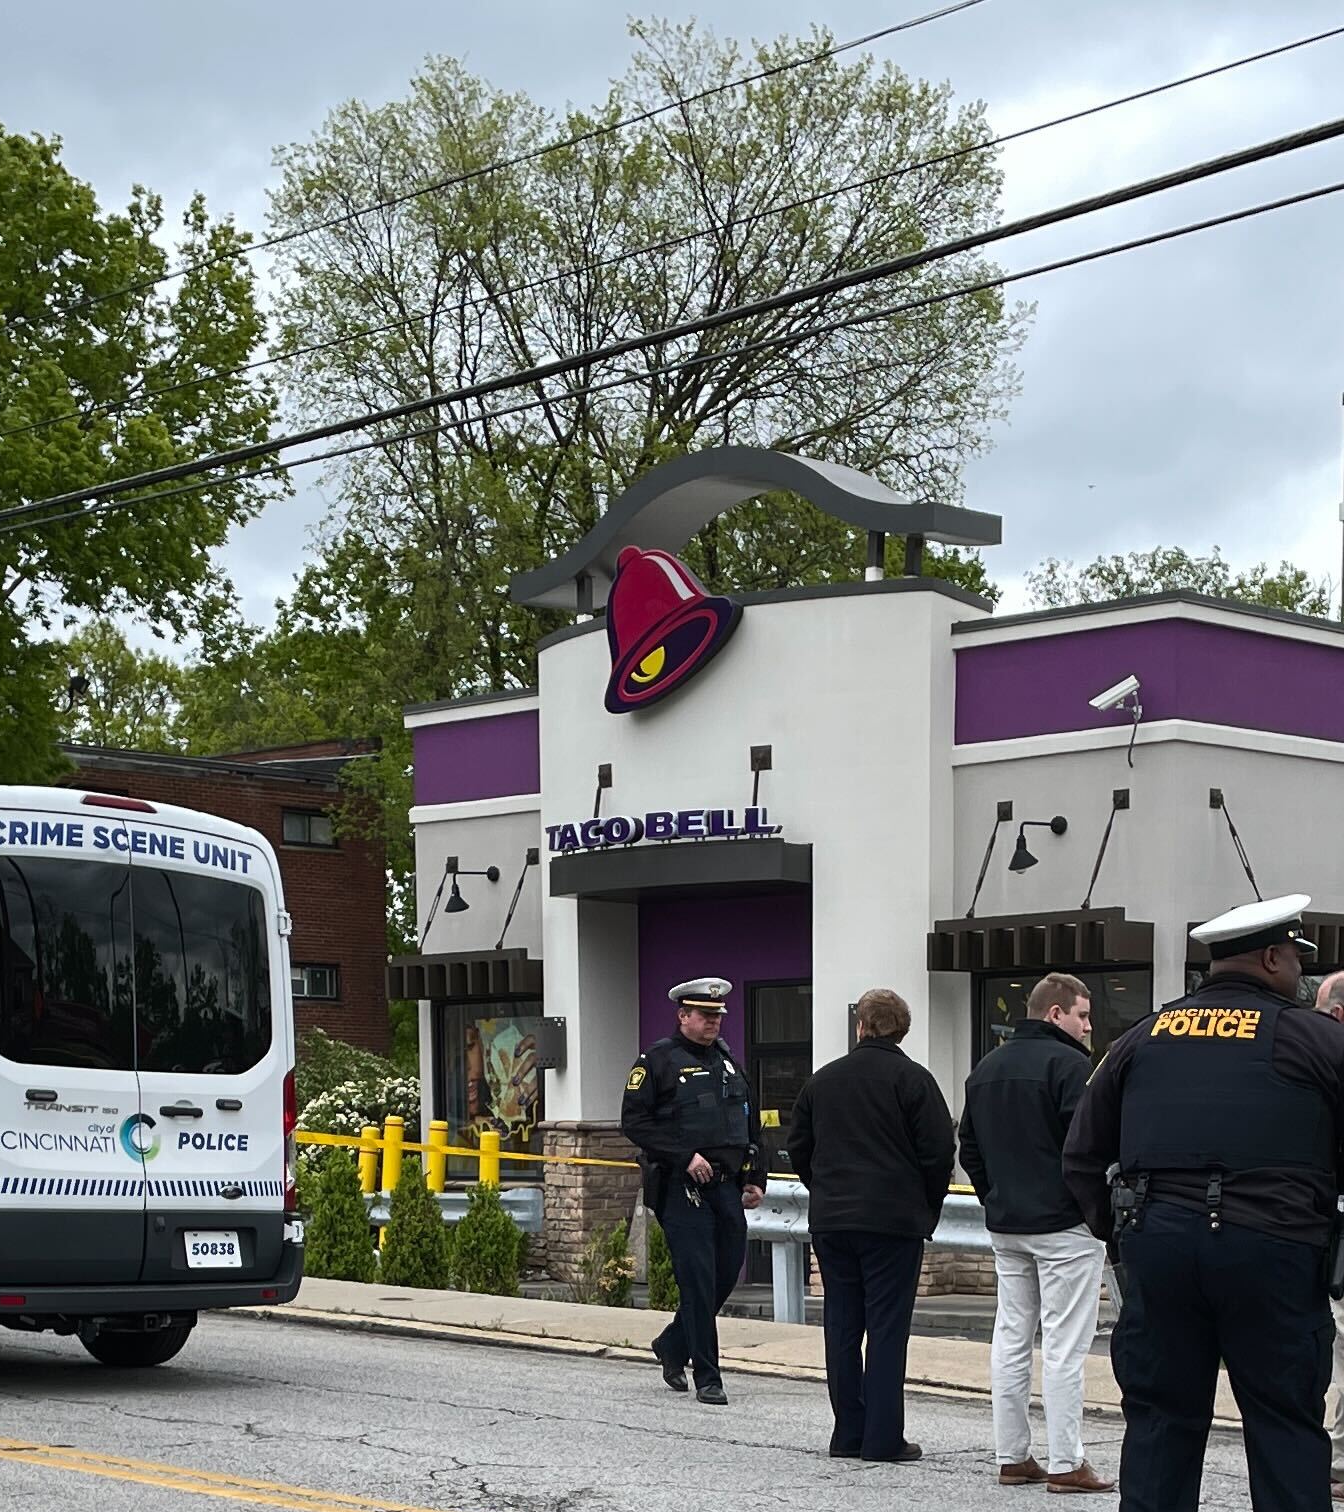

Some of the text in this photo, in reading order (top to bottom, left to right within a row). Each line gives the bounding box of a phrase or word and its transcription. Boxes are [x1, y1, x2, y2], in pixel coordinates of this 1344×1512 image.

[544, 806, 784, 852] TACO BELL
[92, 825, 186, 860] SCENE
[192, 839, 253, 874] UNIT
[1158, 1007, 1262, 1020] CINCINNATI
[1150, 1016, 1260, 1039] POLICE
[23, 1100, 100, 1115] TRANSIT
[87, 1123, 116, 1135] city of
[0, 1129, 117, 1154] CINCINNATI
[177, 1131, 250, 1152] POLICE
[191, 1241, 236, 1256] 50838
